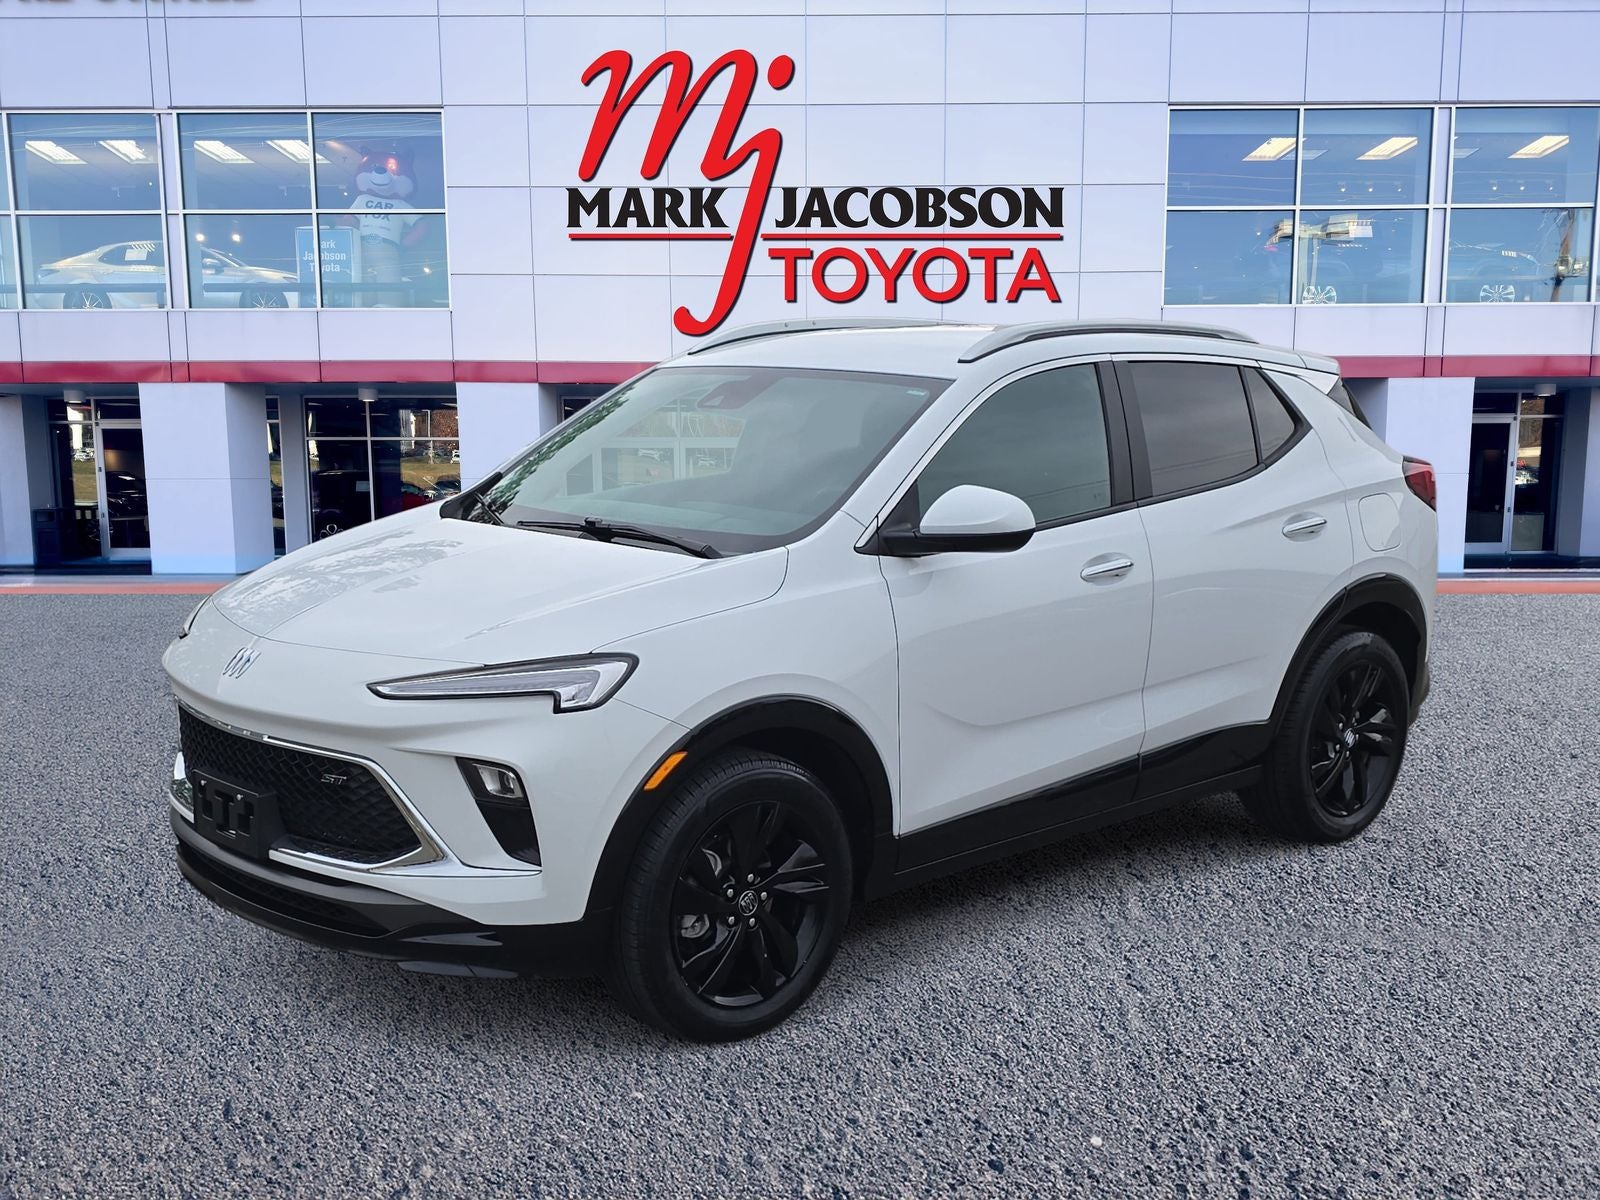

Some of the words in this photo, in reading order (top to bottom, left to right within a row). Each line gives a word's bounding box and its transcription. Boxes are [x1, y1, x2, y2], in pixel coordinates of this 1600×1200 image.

[365, 199, 394, 209] CAR
[566, 187, 729, 228] MARK
[775, 186, 1064, 228] JACOBSON
[314, 239, 336, 249] ark
[303, 250, 346, 261] Jabson
[309, 262, 340, 273] Tyota
[768, 247, 1063, 304] TOYOTA
[320, 772, 347, 785] ST
